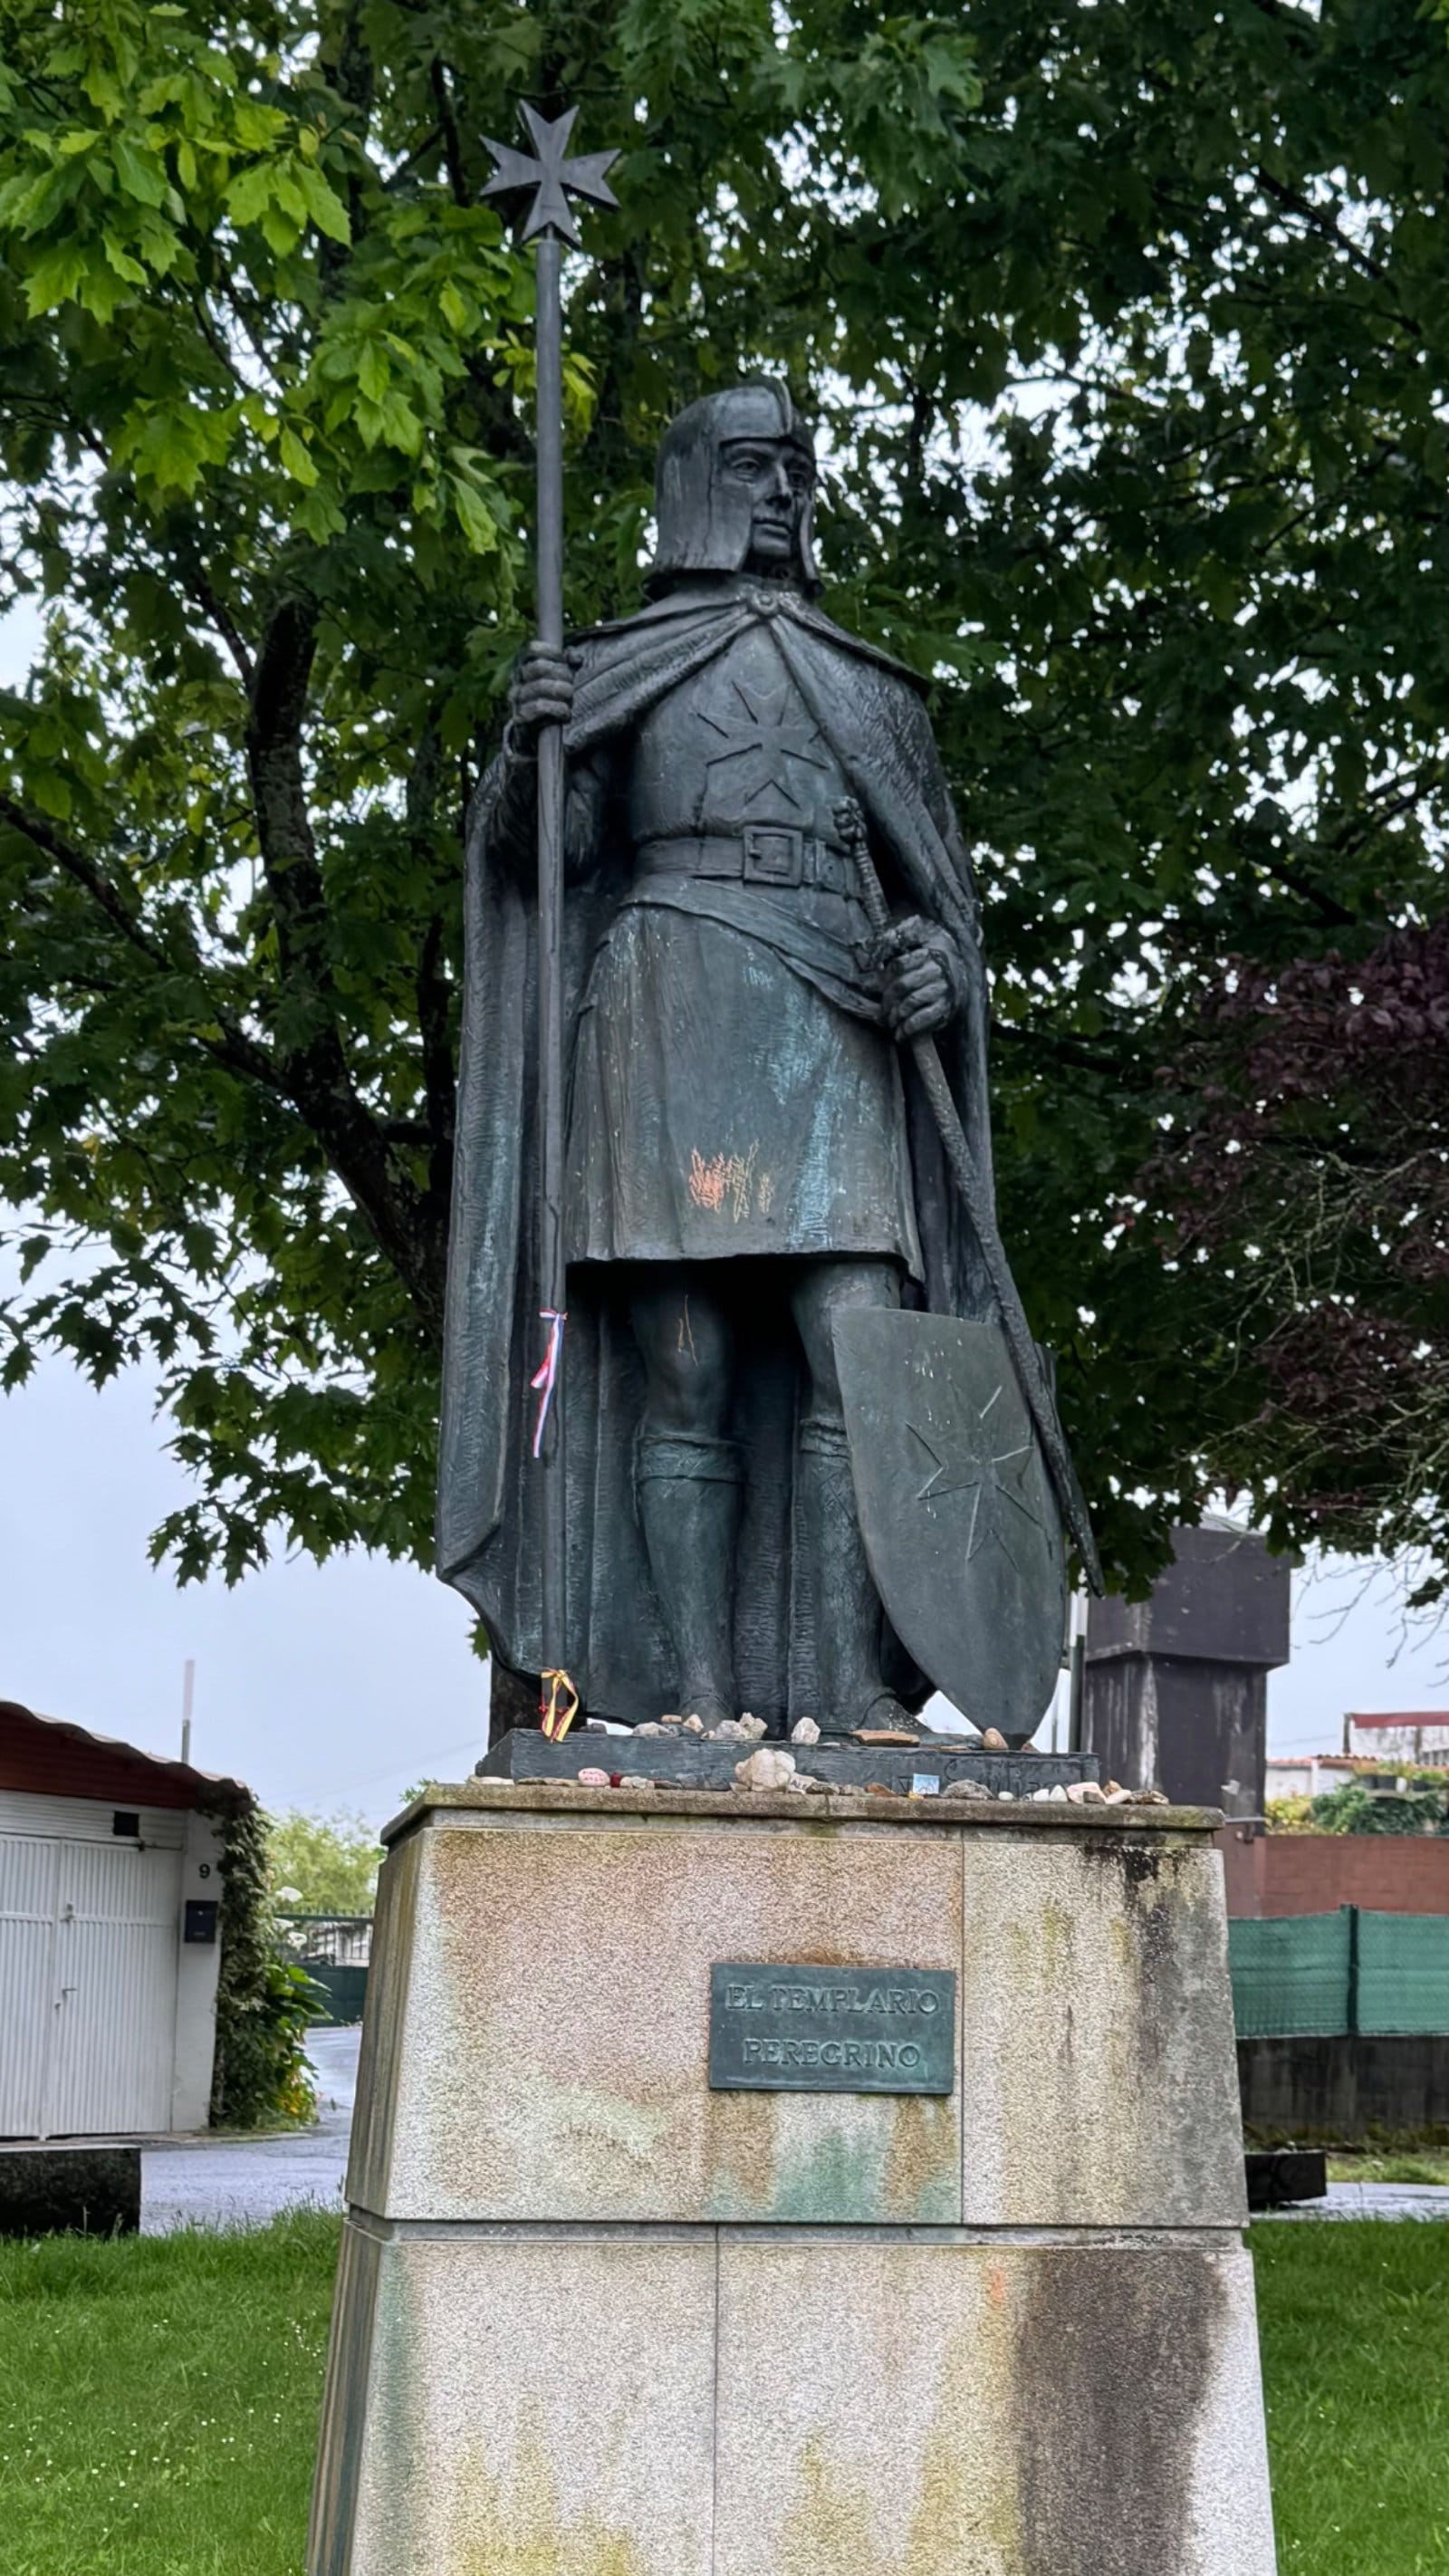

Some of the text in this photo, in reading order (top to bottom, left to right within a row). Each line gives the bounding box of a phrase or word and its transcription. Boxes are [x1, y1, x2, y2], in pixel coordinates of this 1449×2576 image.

[199, 1863, 210, 1879] 9
[727, 1984, 939, 2015] EL TEMPLARIO
[744, 2038, 920, 2068] PEREGRINO
